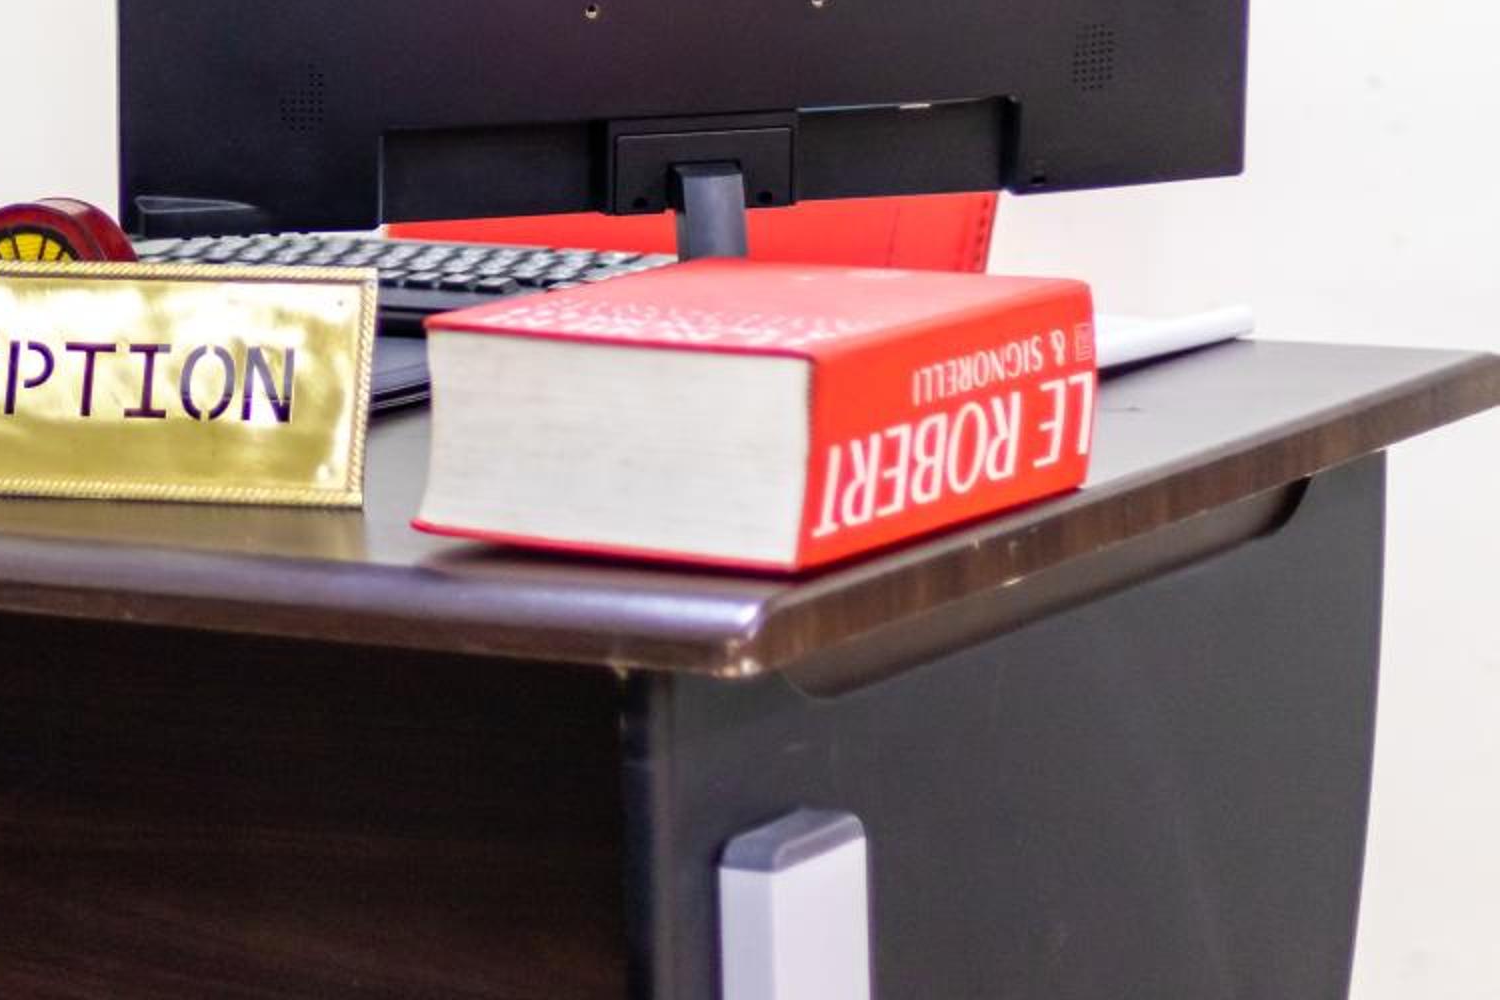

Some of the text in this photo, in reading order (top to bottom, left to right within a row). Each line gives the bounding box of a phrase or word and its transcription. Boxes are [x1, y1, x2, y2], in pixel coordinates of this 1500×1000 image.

[912, 329, 1066, 406] & SIGNORELLI
[811, 371, 1093, 538] LE ROBERT
